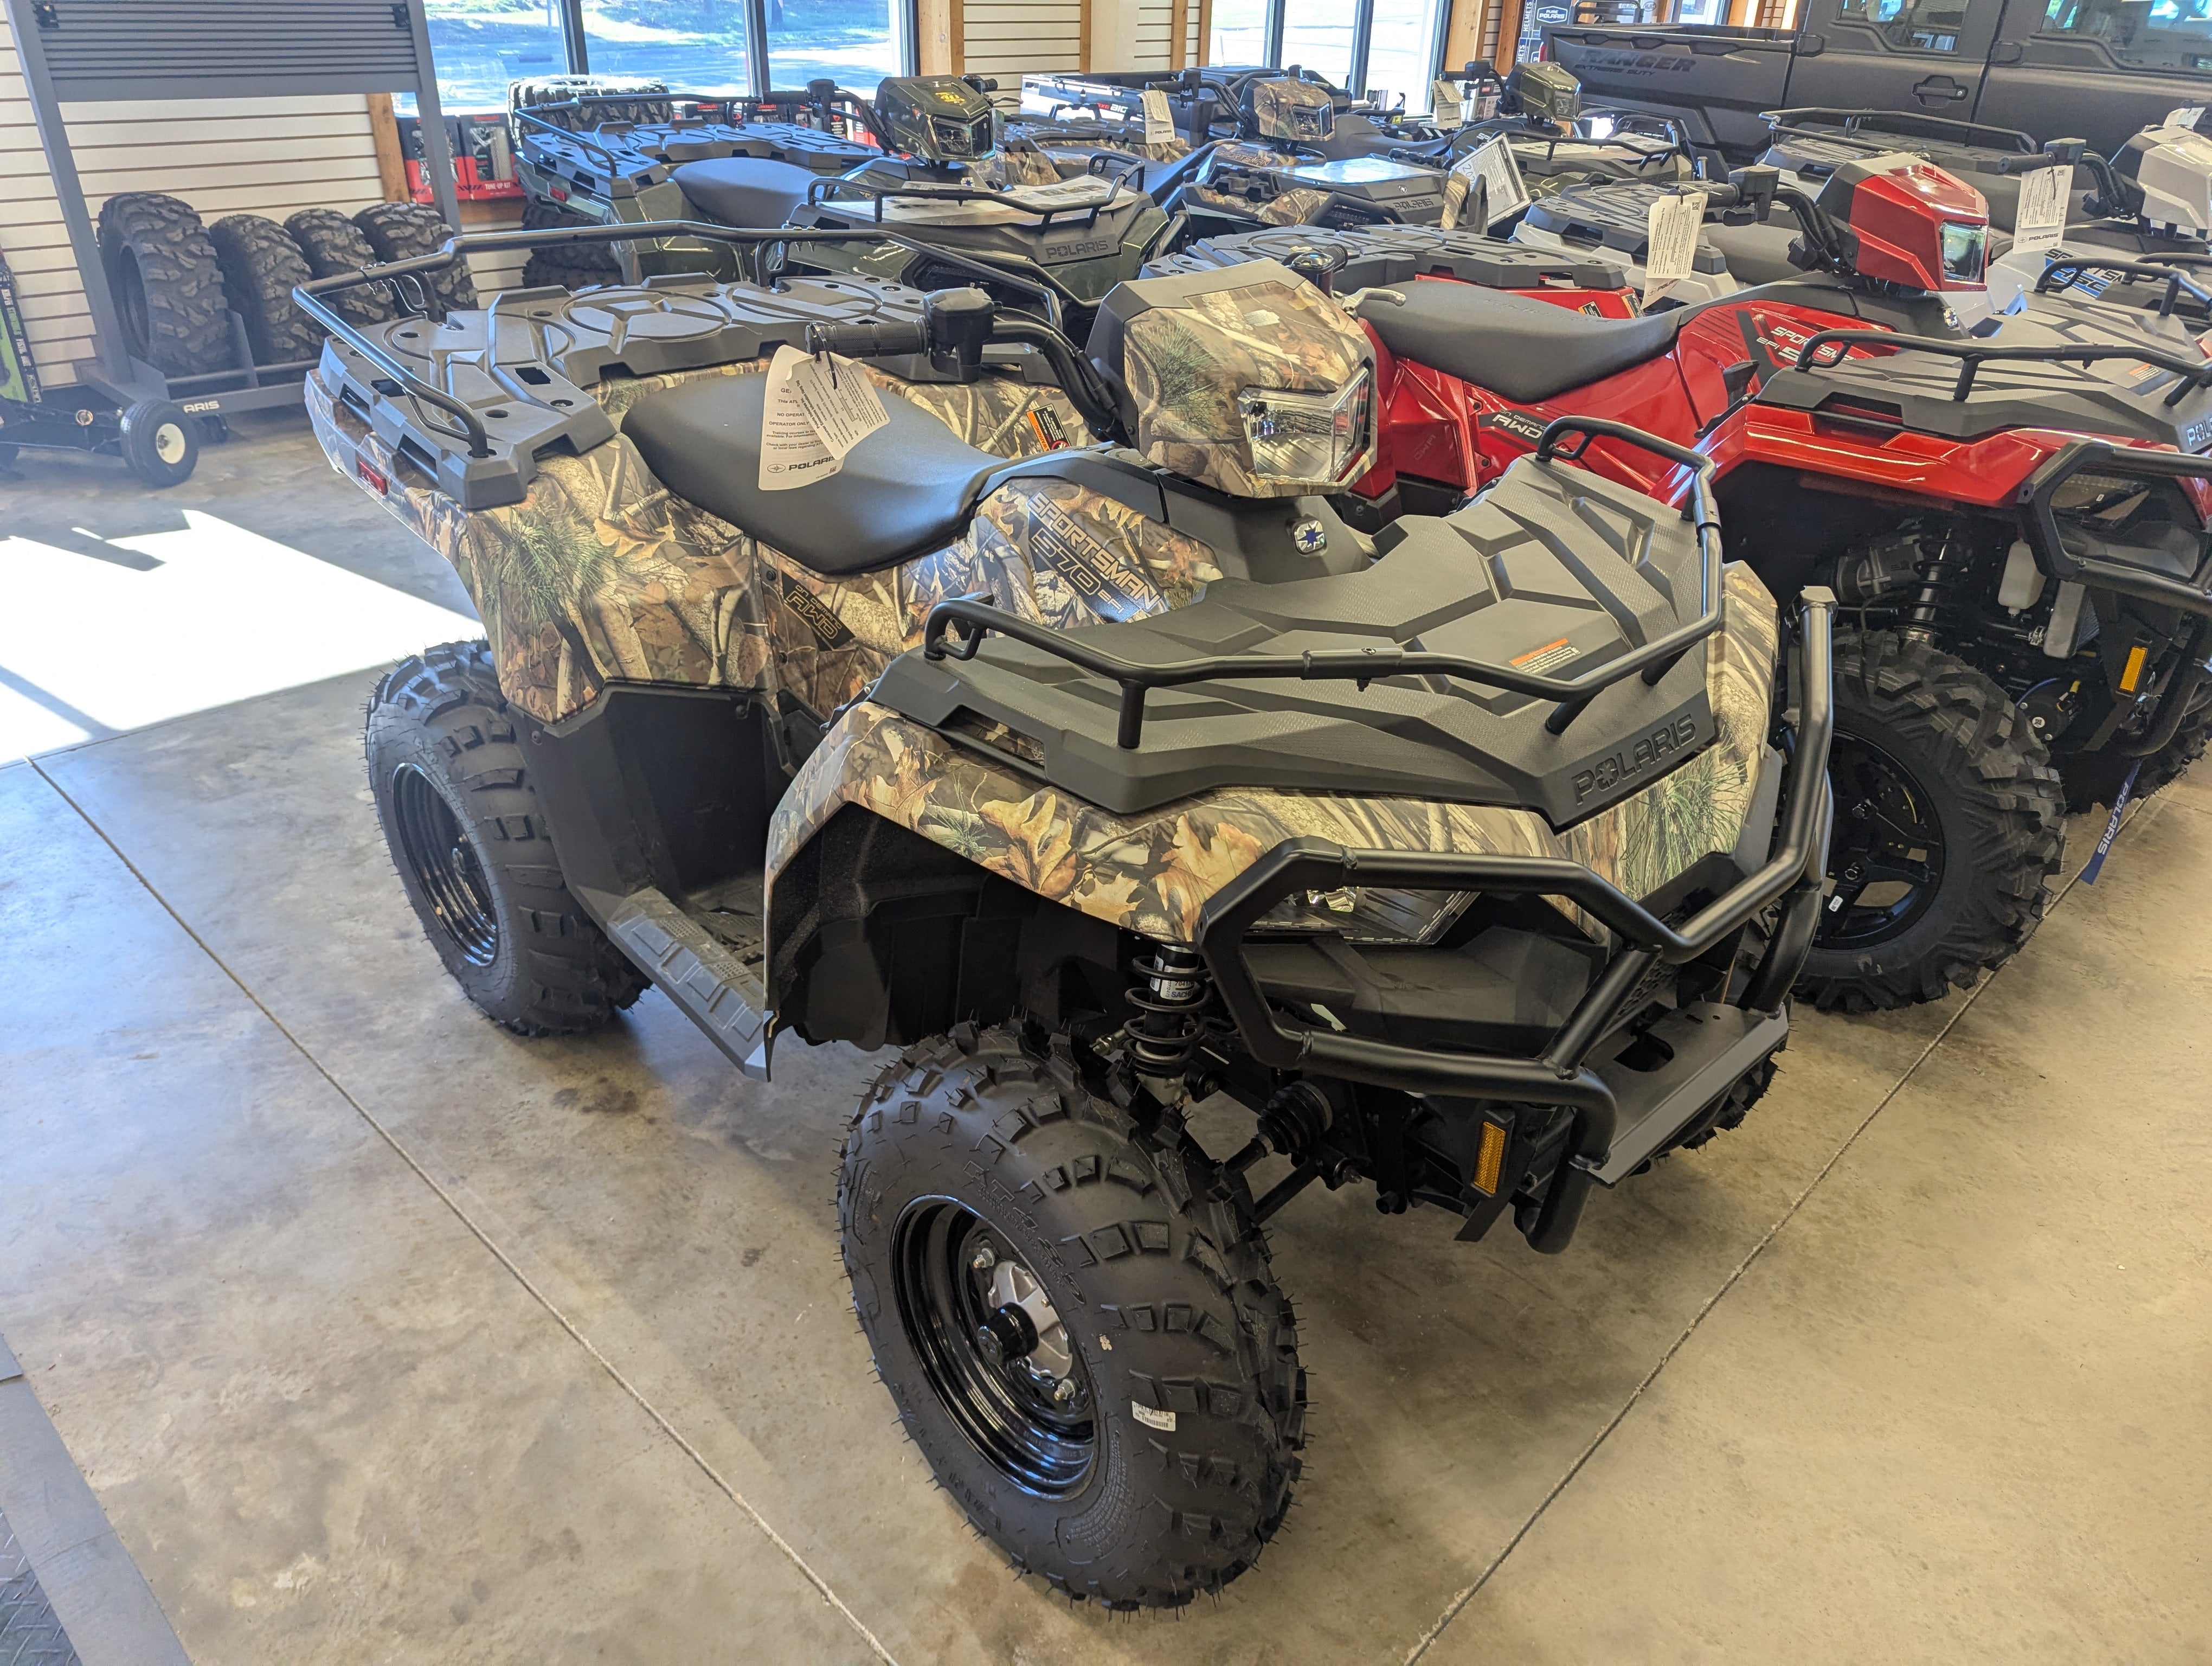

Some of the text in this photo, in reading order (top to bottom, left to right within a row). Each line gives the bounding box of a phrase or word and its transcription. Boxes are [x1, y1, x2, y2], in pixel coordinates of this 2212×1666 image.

[1523, 2, 1532, 31] HELMETS
[1580, 49, 1696, 72] RANGER
[1217, 150, 1270, 167] SPORTSMAN
[1393, 198, 1433, 210] POLARIS
[2029, 233, 2059, 241] POLARIS
[1045, 239, 1109, 260] POLARIS
[1756, 337, 1780, 350] EFI
[183, 400, 220, 413] ARIS
[821, 425, 834, 443] Consumer
[1492, 414, 1542, 439] AWD
[1514, 415, 1547, 431] DEMAND
[1033, 424, 1048, 449] WARNING
[788, 456, 835, 471] POLARIS
[1027, 491, 1164, 612] SPORTSMAN
[1031, 527, 1124, 614] 570 EFI
[786, 591, 839, 640] AWD
[795, 585, 843, 629] ON DEMAND
[1571, 713, 1697, 807] POLARIS
[2097, 781, 2130, 856] POLARIS
